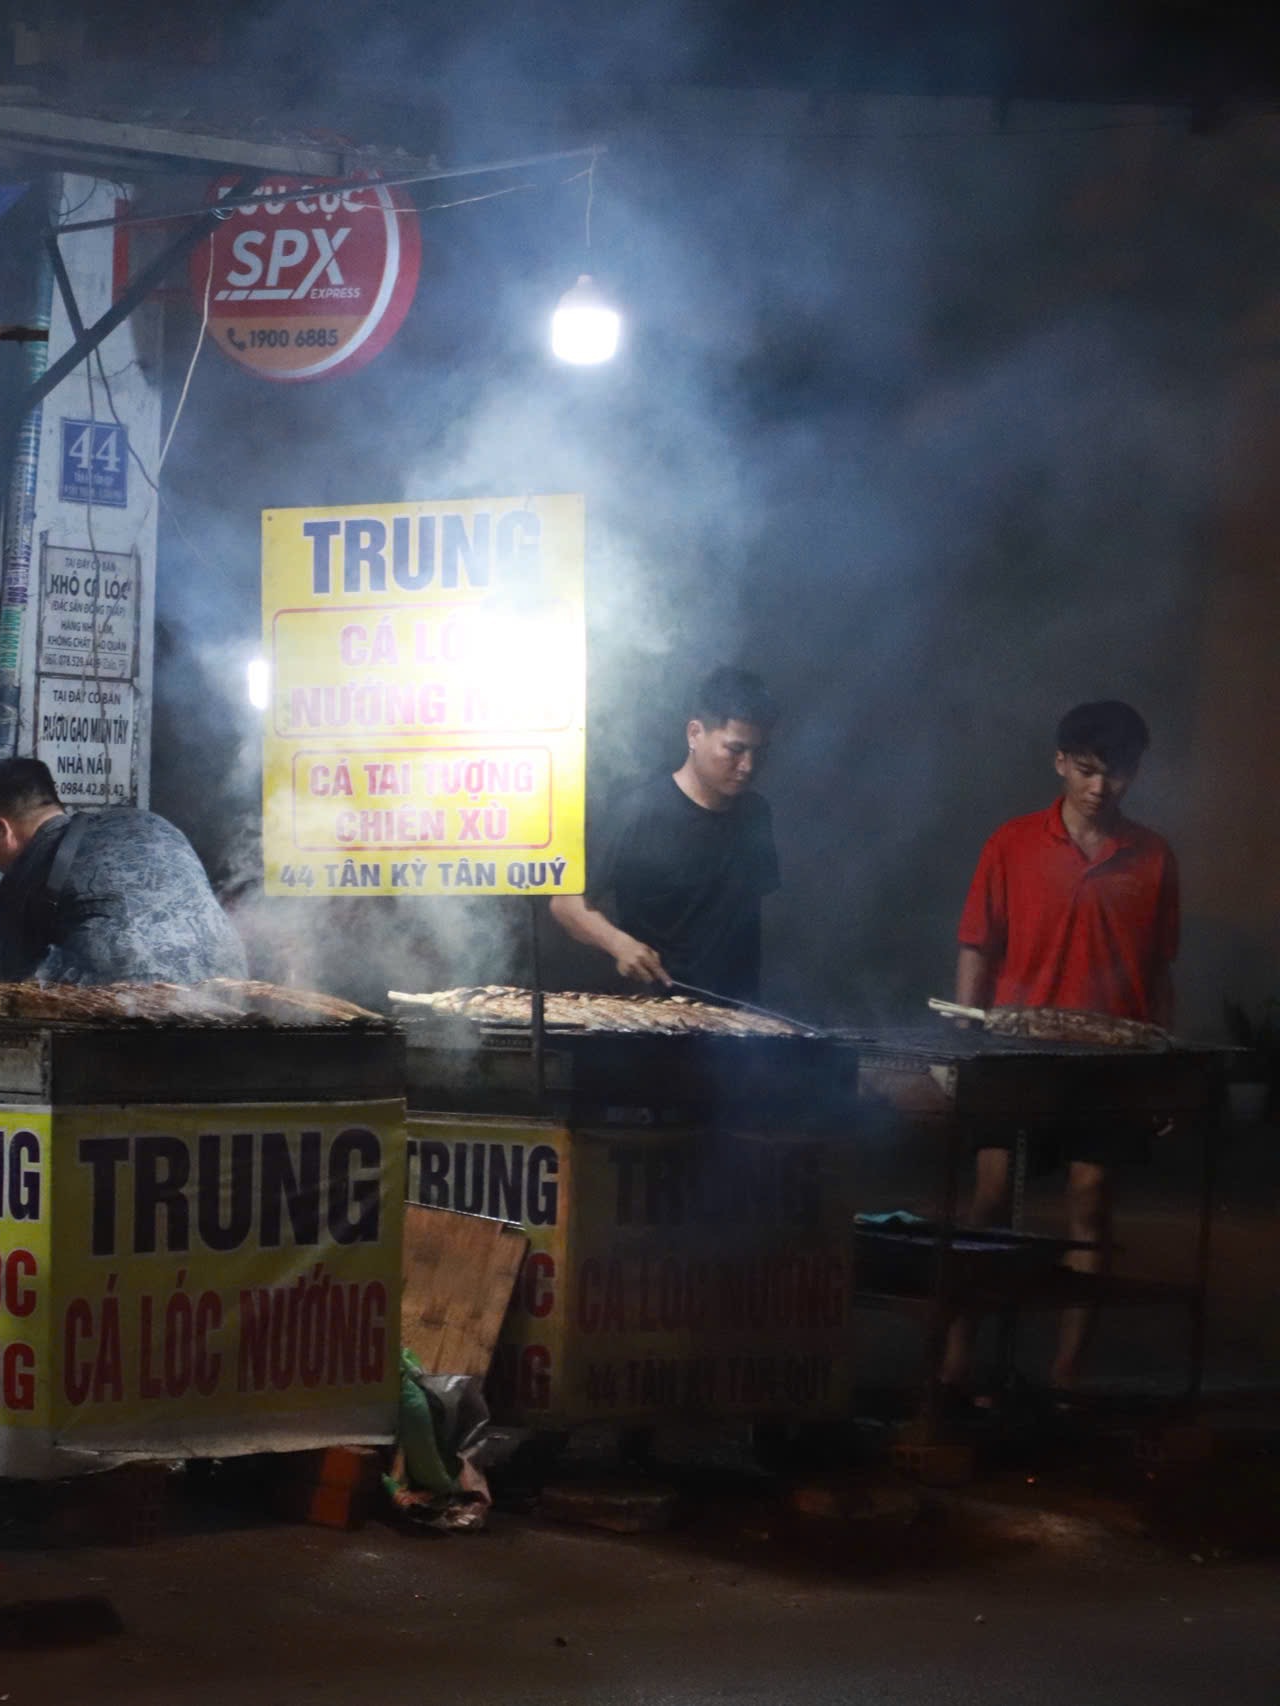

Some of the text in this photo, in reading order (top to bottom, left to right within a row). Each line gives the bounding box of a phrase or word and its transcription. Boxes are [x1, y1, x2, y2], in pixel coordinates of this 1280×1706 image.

[226, 227, 352, 299] SPX
[310, 287, 361, 300] EXPRESS
[249, 328, 339, 349] 1900 6885
[69, 426, 121, 472] 44
[303, 511, 542, 594] TRUNG
[310, 758, 353, 796] CÁ
[363, 763, 413, 795] TAI
[324, 858, 380, 887] TÂN
[391, 857, 427, 887] KỲ
[438, 858, 495, 887] TÂN
[507, 857, 567, 889] QUÝ
[80, 1129, 381, 1256] TRUNG
[65, 1263, 388, 1407] CÁ LÓC NƯỚNG
